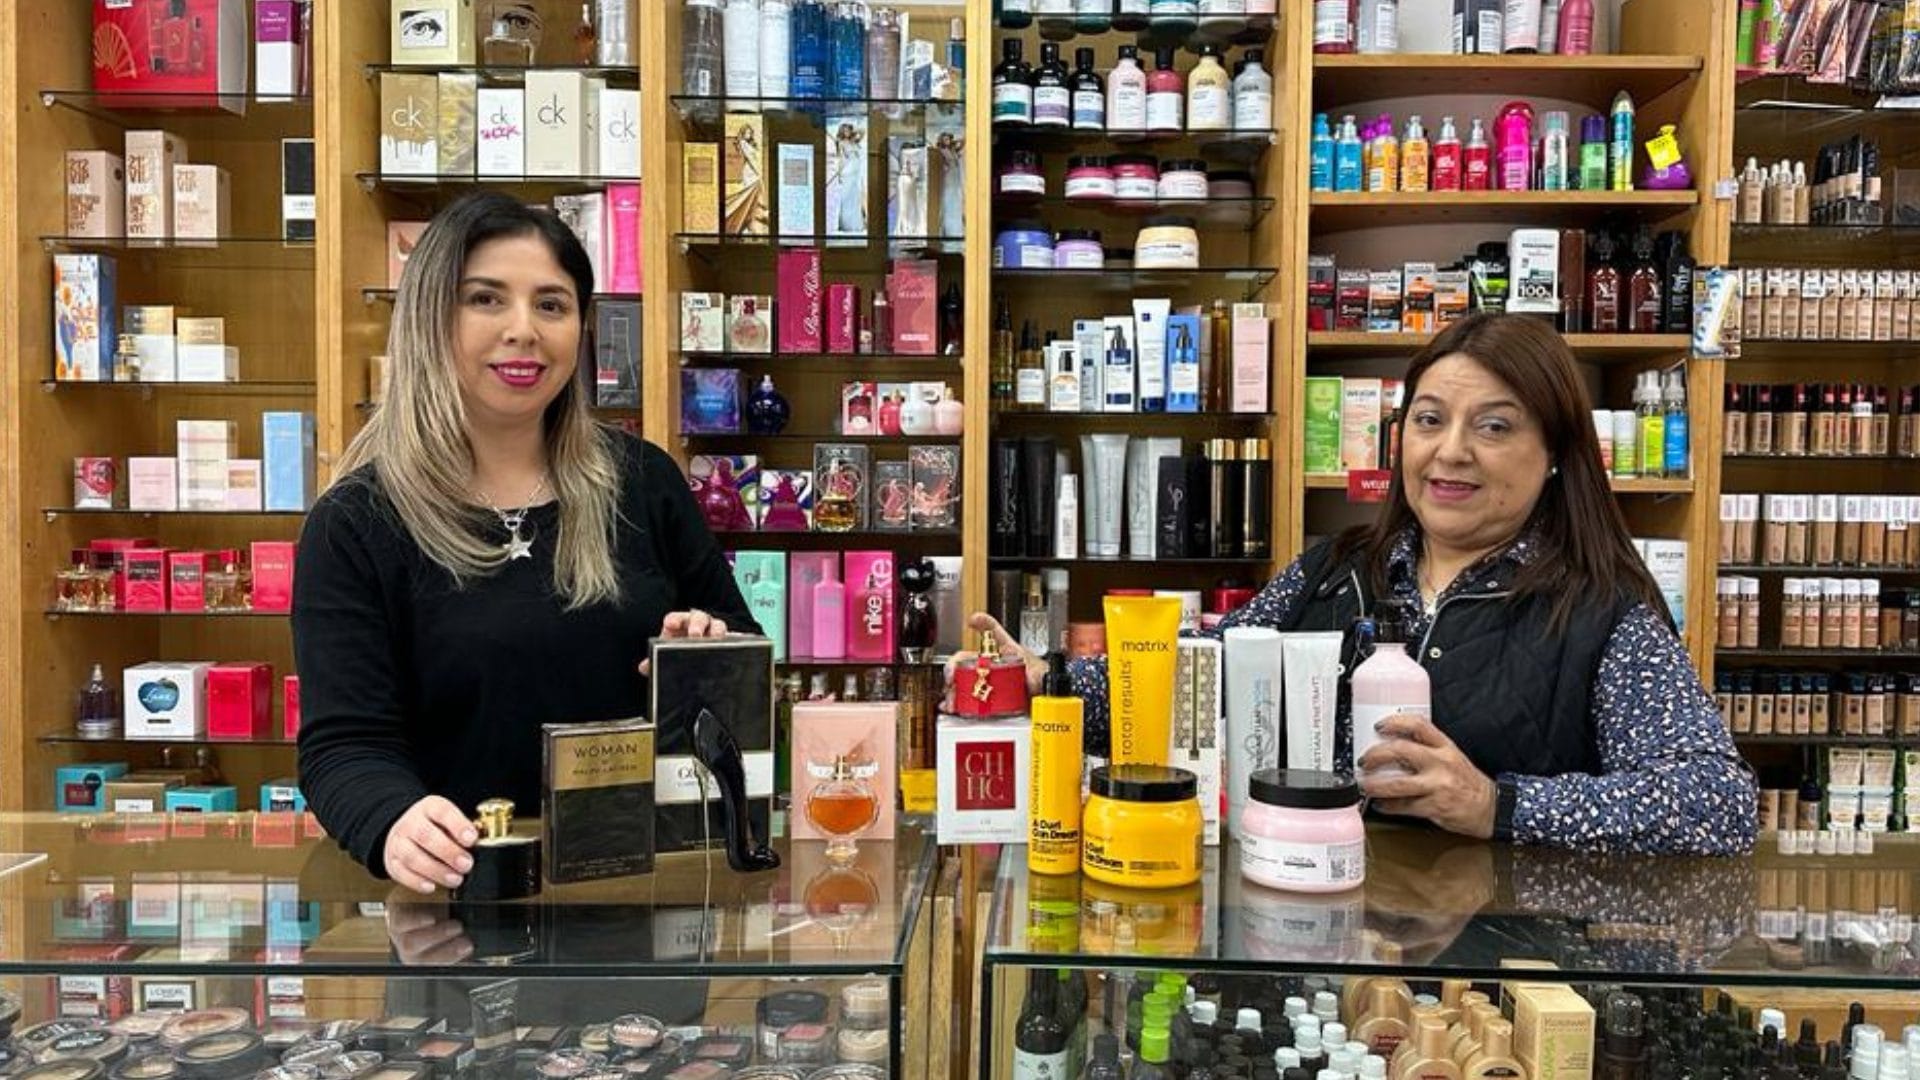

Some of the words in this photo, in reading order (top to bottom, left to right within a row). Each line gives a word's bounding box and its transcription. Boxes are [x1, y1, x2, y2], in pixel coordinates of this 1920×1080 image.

[391, 95, 423, 129] ck
[489, 105, 508, 125] ck
[537, 94, 567, 124] ck
[608, 109, 636, 139] ck
[1120, 639, 1170, 653] matrix
[1119, 660, 1134, 715] results
[573, 743, 638, 759] WOMAN
[1121, 717, 1134, 756] total
[1310, 731, 1321, 772] ASTIAN
[965, 752, 1004, 777] CH
